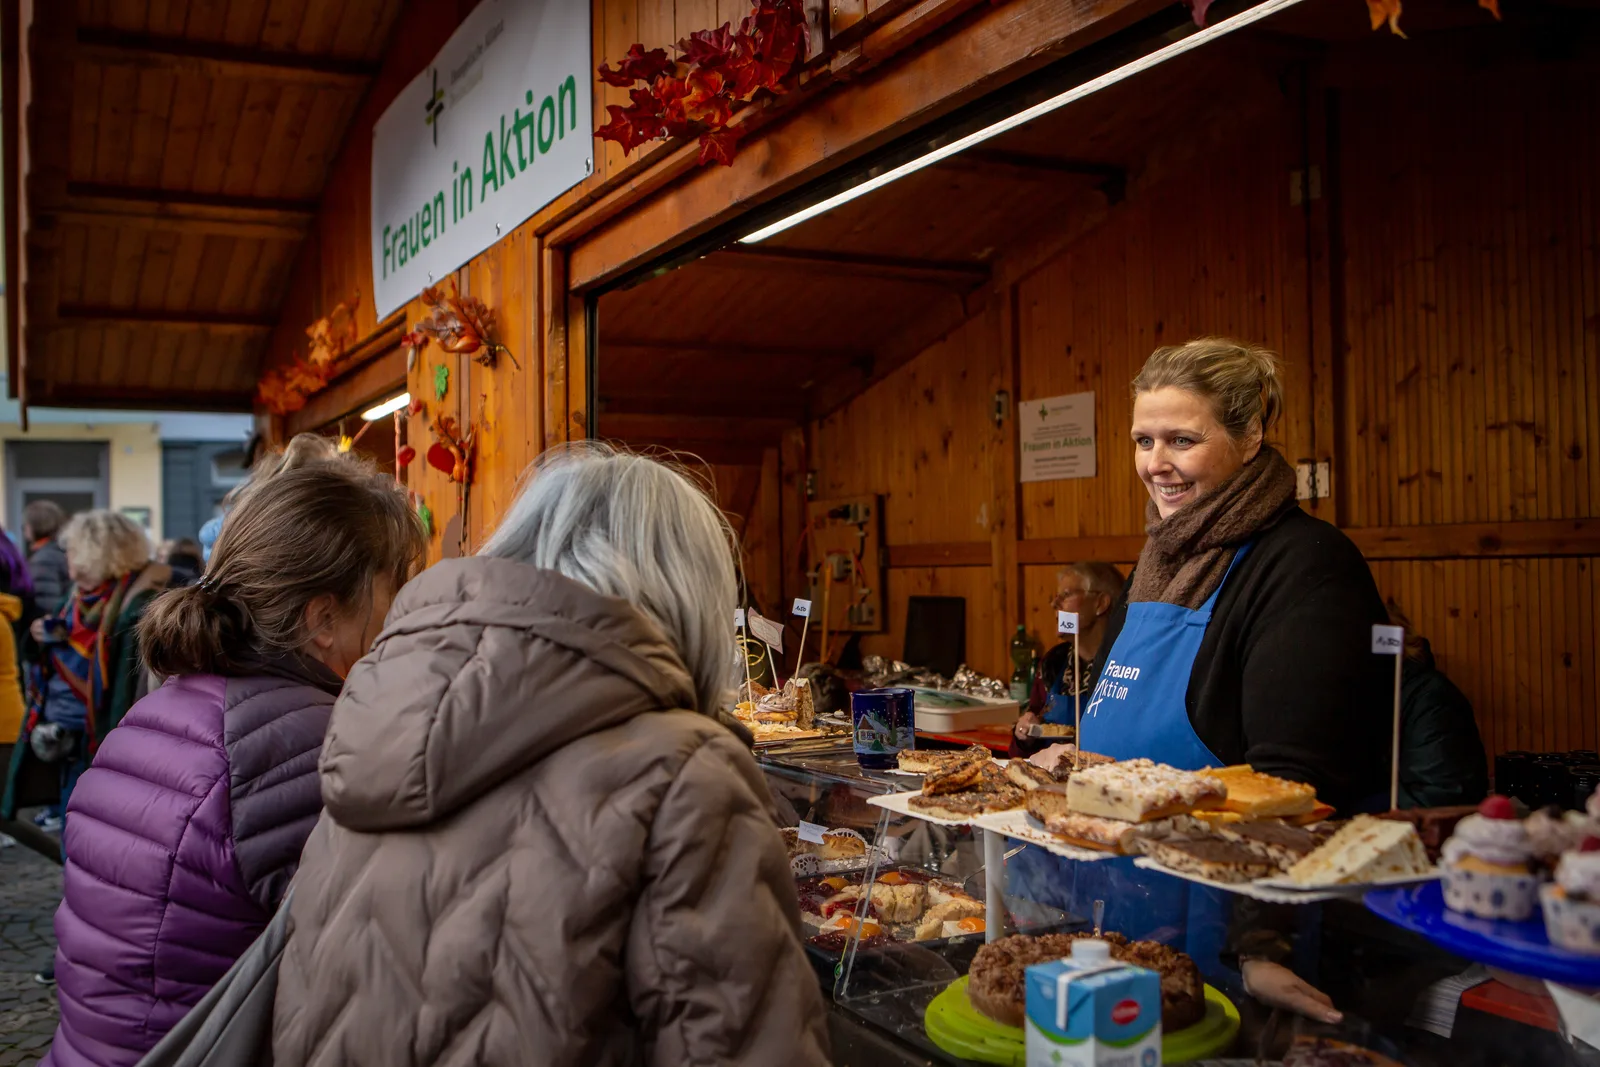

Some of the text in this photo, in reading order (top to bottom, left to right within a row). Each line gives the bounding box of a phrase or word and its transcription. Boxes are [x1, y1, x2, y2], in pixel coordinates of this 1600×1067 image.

[382, 189, 445, 281] Frauen
[453, 160, 473, 225] in
[480, 74, 577, 204] Aktion
[1062, 437, 1092, 448] Aktion
[1104, 659, 1141, 681] Frauen
[1087, 678, 1129, 718] Aktion
